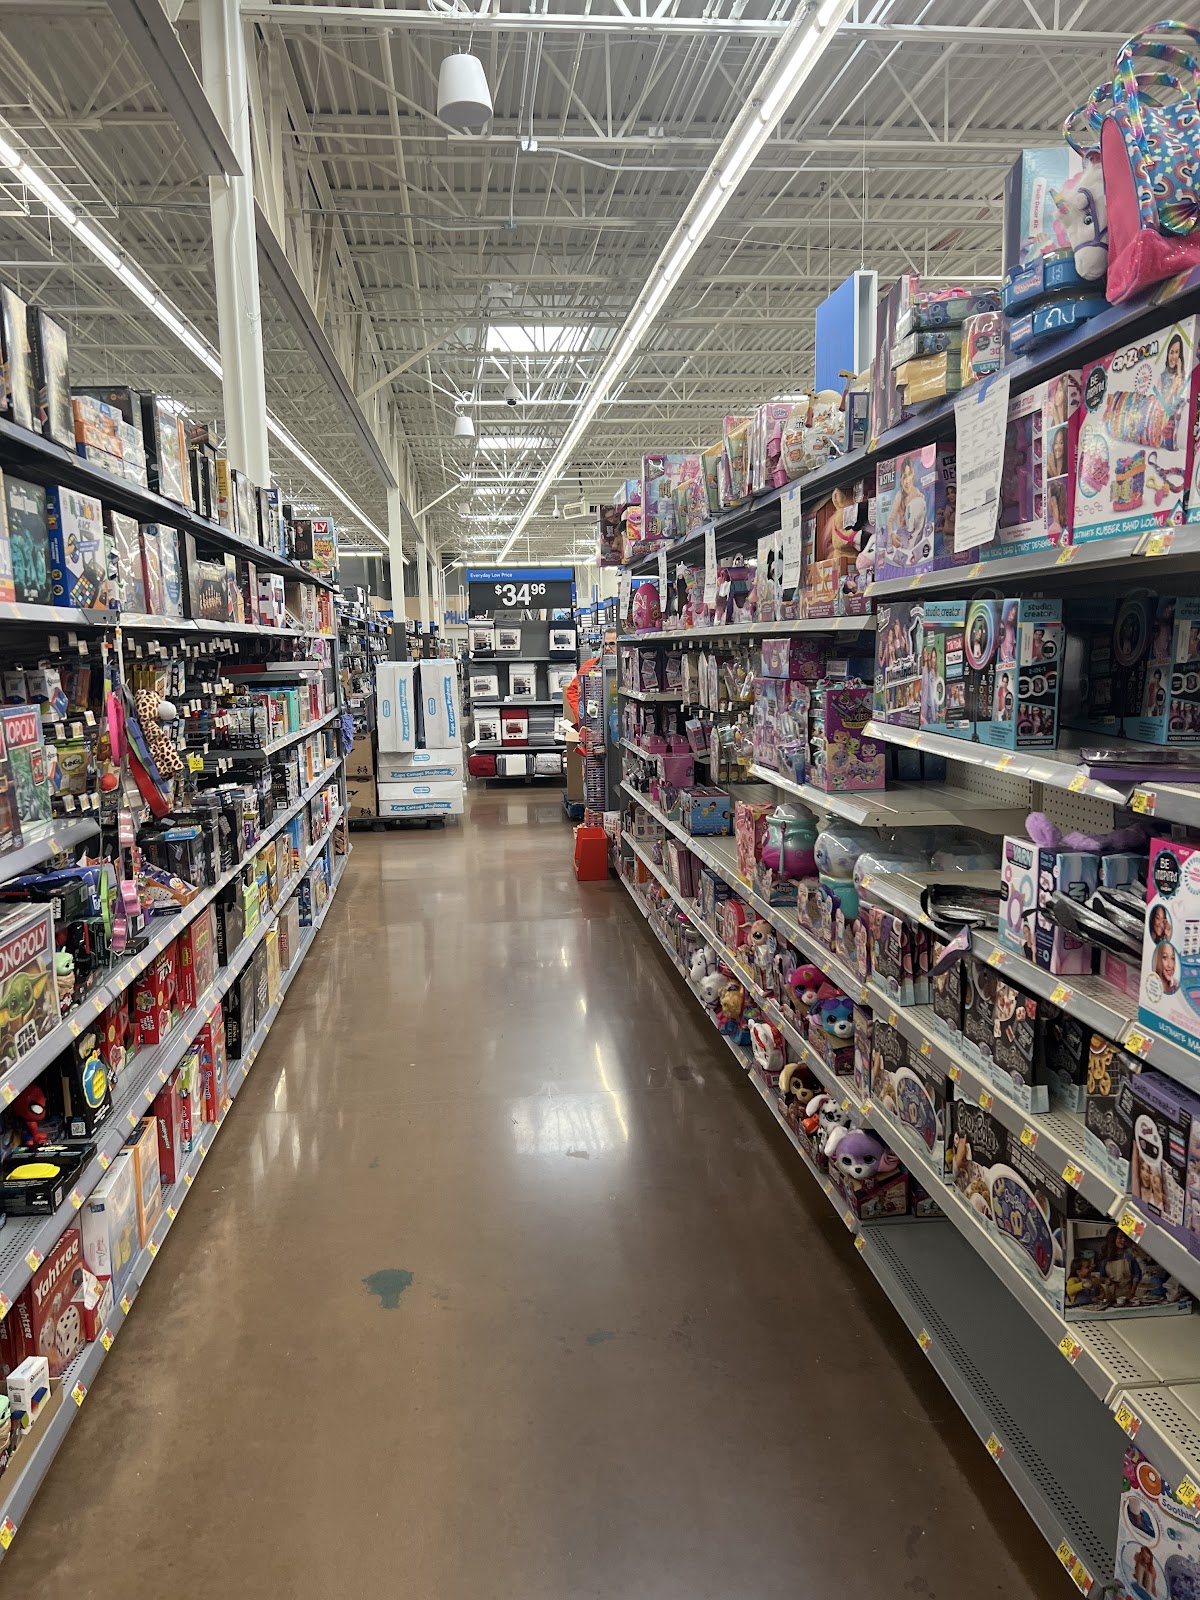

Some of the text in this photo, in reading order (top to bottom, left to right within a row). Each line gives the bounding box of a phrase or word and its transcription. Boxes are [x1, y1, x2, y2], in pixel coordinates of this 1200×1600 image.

[1090, 374, 1099, 386] BE
[1096, 524, 1121, 536] RUBBER
[1122, 519, 1140, 532] BAND
[1140, 515, 1164, 529] LOOM!
[940, 606, 961, 617] creator
[1024, 610, 1052, 618] creator
[1028, 603, 1051, 611] studio
[946, 638, 963, 650] TikTok
[1160, 858, 1170, 869] BE
[16, 1023, 35, 1048] STAR
[1158, 1022, 1187, 1042] ULTIMATE
[18, 1034, 37, 1058] WARS
[34, 1238, 79, 1306] Yahtzee
[17, 1301, 32, 1339] Yahtzee
